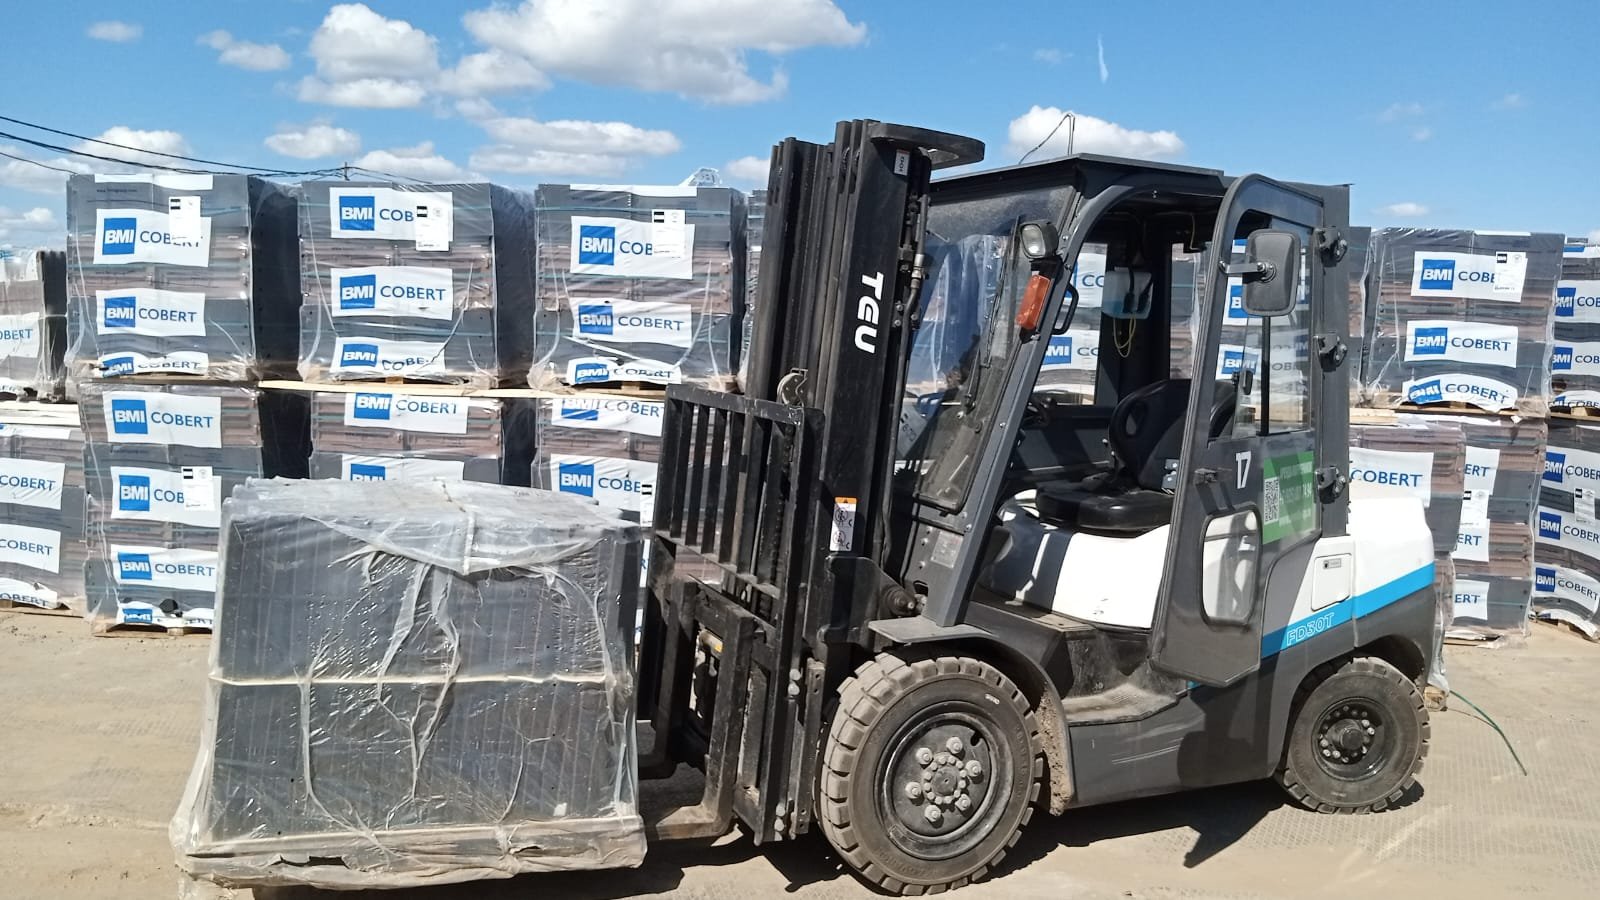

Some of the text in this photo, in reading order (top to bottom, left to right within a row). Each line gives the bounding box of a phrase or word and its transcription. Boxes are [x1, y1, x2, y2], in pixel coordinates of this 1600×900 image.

[341, 207, 414, 222] BMI COB
[104, 230, 134, 244] BMI
[581, 237, 653, 256] BMI COB
[1422, 269, 1452, 281] BMI
[341, 285, 447, 301] BMI COBERT
[106, 307, 198, 323] BMI COBERT
[854, 271, 884, 354] TEU
[580, 315, 685, 332] BMI COBERT
[1415, 335, 1511, 352] BMI COBERT
[344, 351, 376, 361] BMI
[1575, 355, 1600, 364] COB
[1445, 383, 1510, 404] COBERT
[357, 396, 391, 410] BMI
[115, 410, 214, 428] BMI COBERT
[1235, 451, 1251, 489] 17
[1465, 464, 1490, 477] ERT
[1544, 460, 1563, 471] BMI
[0, 475, 56, 491] COBERT
[561, 474, 642, 493] BMI COBE
[1351, 469, 1423, 488] COBERT
[121, 488, 184, 504] BMI COB
[1540, 519, 1600, 543] BMI COBER
[1457, 533, 1482, 546] ERT
[121, 561, 215, 577] BMI COBERT
[1536, 575, 1599, 601] BMI COBERT
[1454, 593, 1480, 604] ERT
[1286, 612, 1335, 647] FD30T
